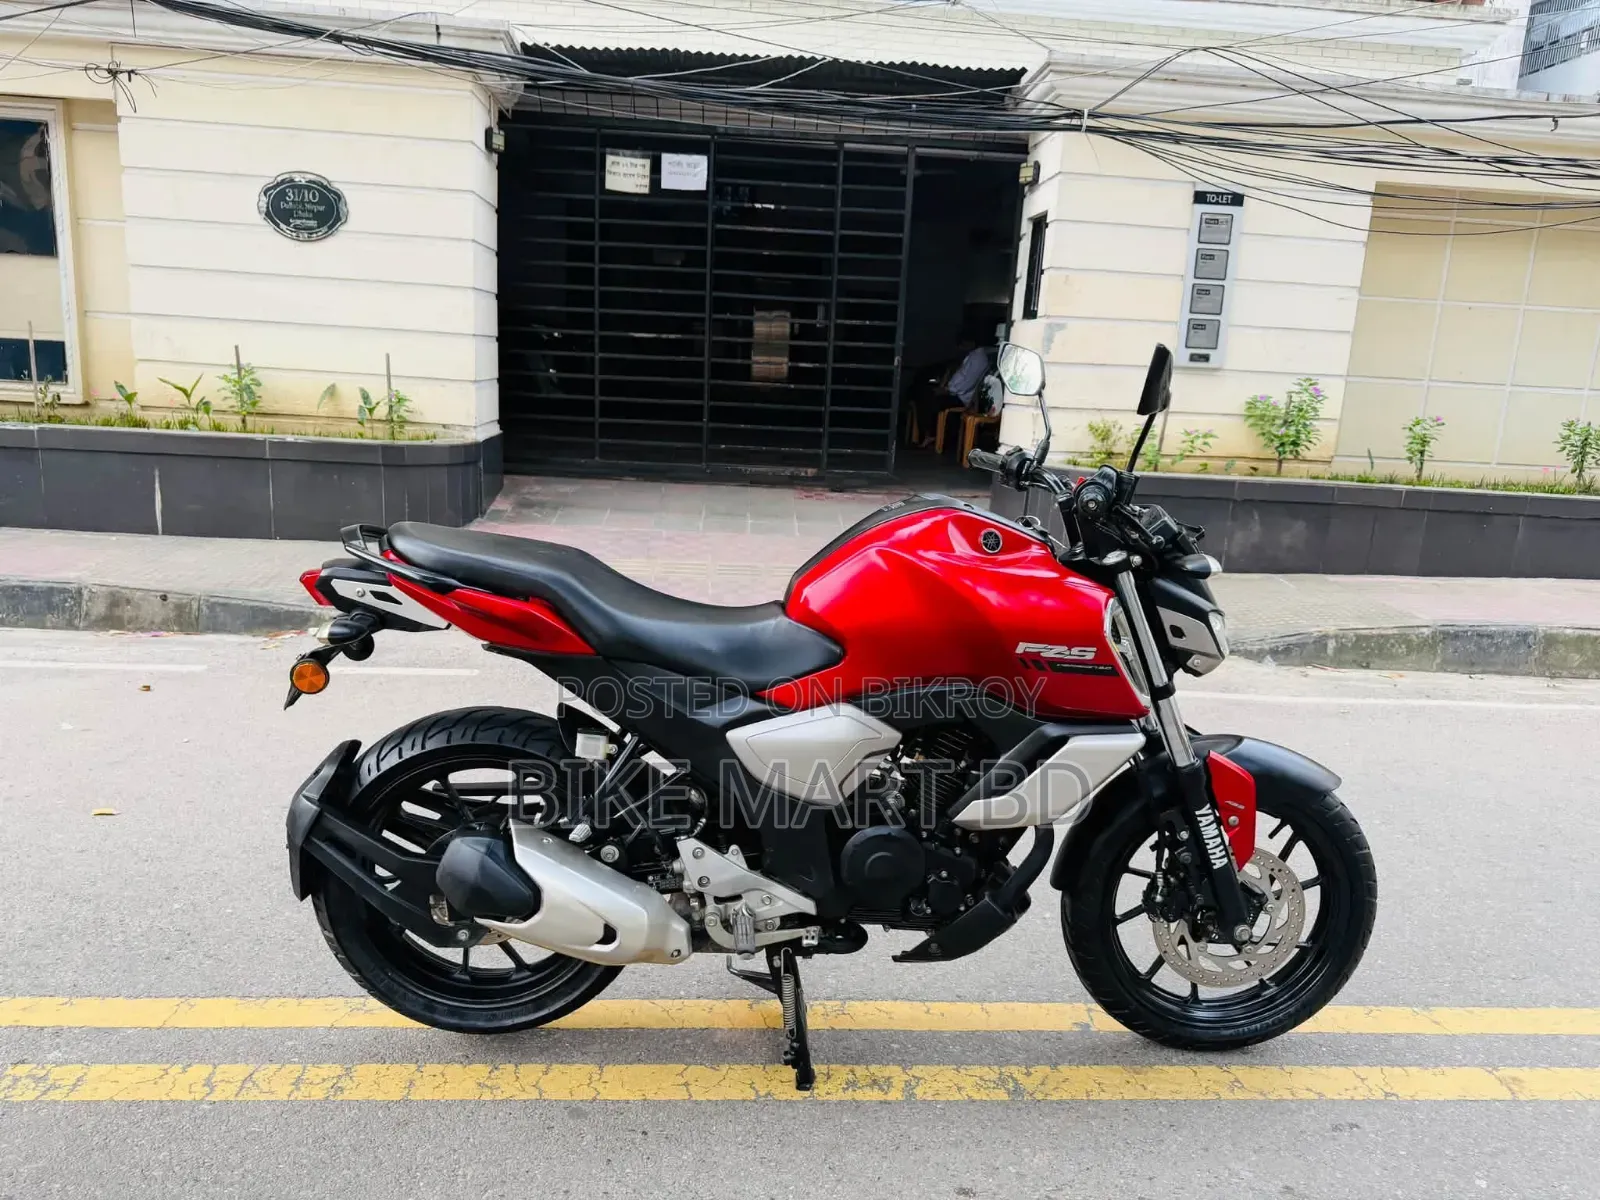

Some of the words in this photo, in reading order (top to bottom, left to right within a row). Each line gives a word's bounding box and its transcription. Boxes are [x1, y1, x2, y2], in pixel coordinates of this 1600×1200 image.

[285, 188, 320, 202] 31/10
[1206, 193, 1234, 204] TO-LET
[1195, 803, 1228, 870] YAMAHA
